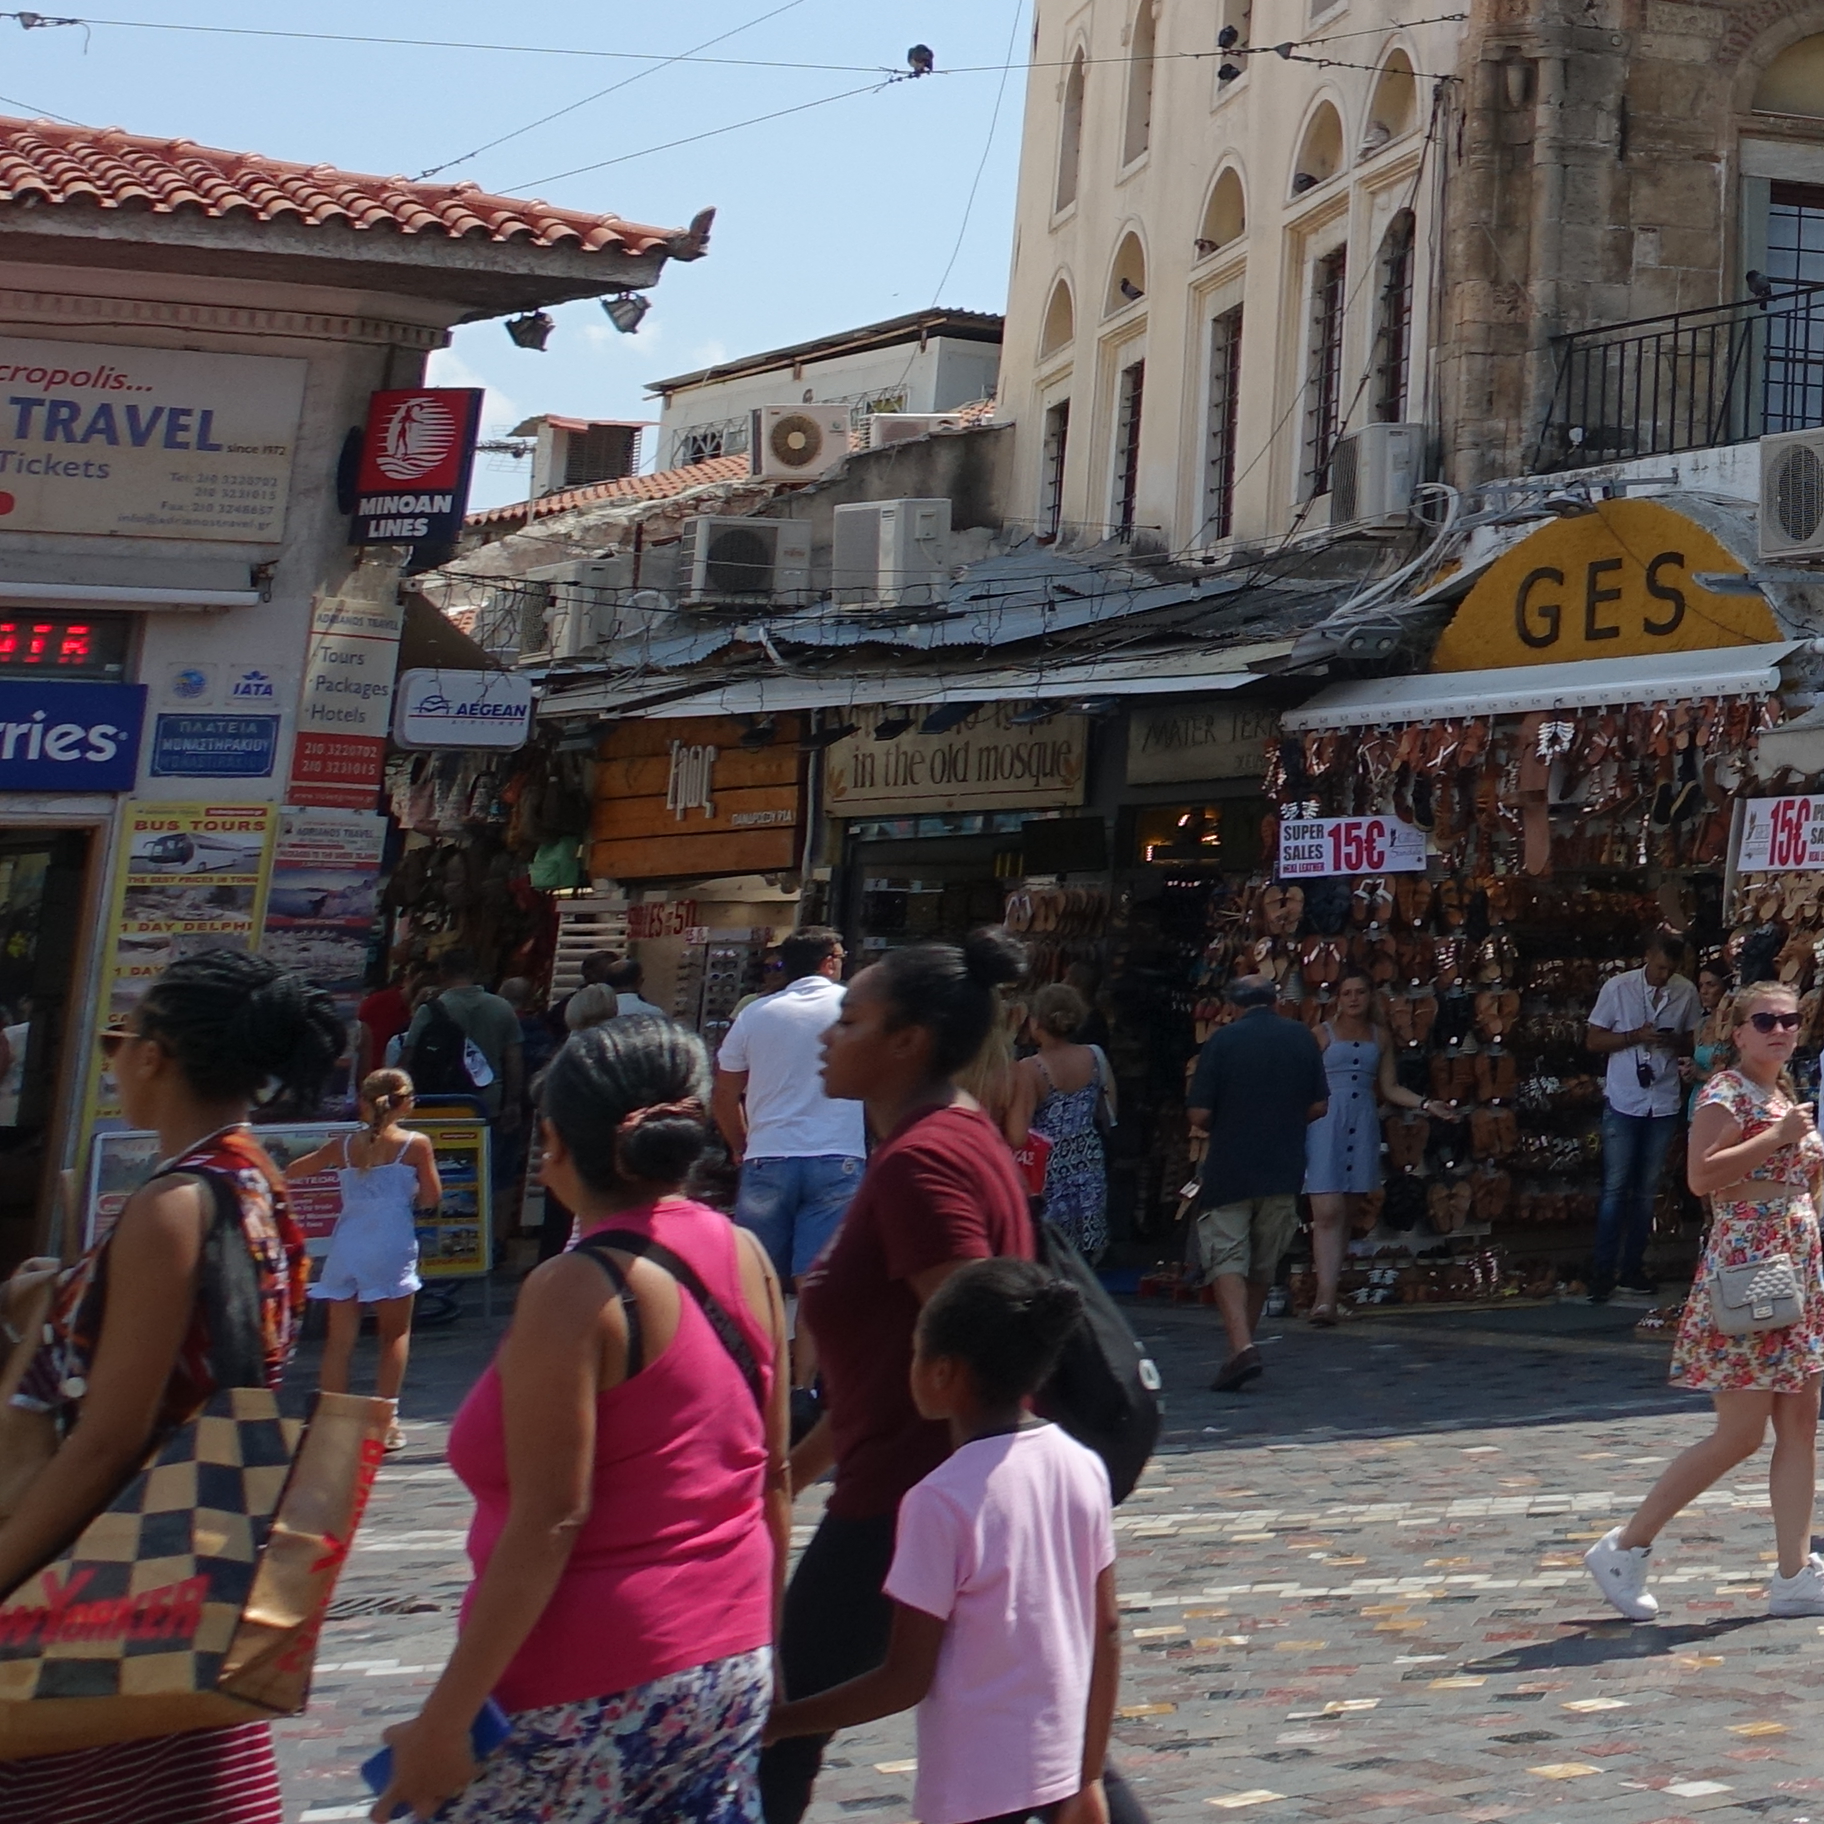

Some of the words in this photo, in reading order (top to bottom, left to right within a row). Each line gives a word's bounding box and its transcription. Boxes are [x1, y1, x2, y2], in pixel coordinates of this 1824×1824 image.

[10, 396, 222, 451] TRAVEL
[227, 443, 258, 454] since
[0, 449, 110, 479] Tickets
[358, 495, 453, 516] MINOAN
[368, 518, 429, 538] LINES
[1515, 551, 1686, 649] GES
[321, 646, 365, 665] Tours
[233, 683, 273, 696] IATA
[315, 675, 389, 699] Packages
[311, 704, 365, 723] Hotels
[456, 702, 527, 718] AEGEAN
[0, 710, 118, 761] ries
[179, 722, 257, 734] ΠΛΑΤΕΙΑ
[304, 742, 323, 754] 210
[852, 745, 875, 789] in
[884, 743, 925, 787] the
[930, 740, 970, 784] old
[977, 739, 1072, 787] mosque
[134, 820, 180, 832] BUS
[190, 820, 266, 832] TOURS
[1283, 824, 1324, 841] SUPER
[1768, 797, 1811, 867] 15€
[1283, 844, 1323, 861] SALES
[1328, 820, 1385, 871] 15€
[138, 923, 175, 932] DAY
[183, 922, 253, 931] DELPHI
[131, 967, 165, 975] DAY
